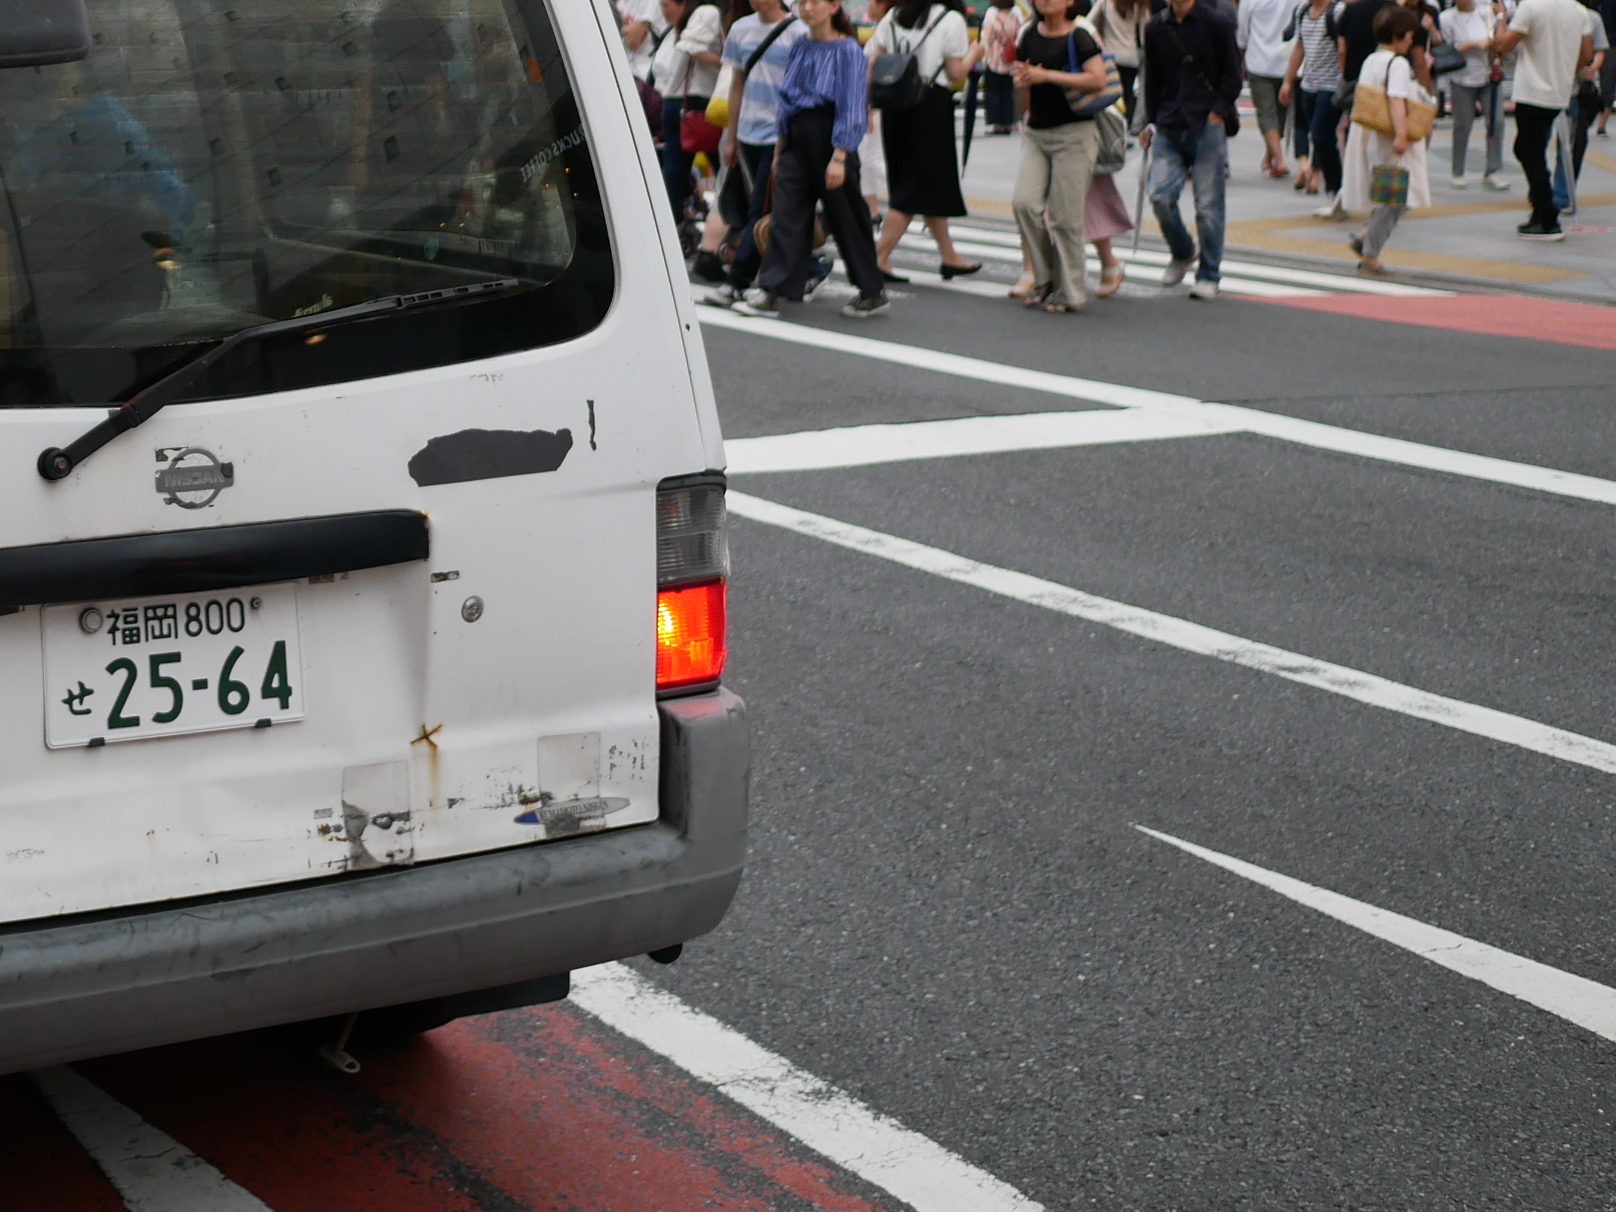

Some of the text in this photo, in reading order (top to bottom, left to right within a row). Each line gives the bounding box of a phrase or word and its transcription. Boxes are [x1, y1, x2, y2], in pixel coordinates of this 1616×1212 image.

[164, 470, 225, 488] NISSAN
[105, 597, 246, 647] 福岡 800
[61, 639, 293, 730] せ 25-64
